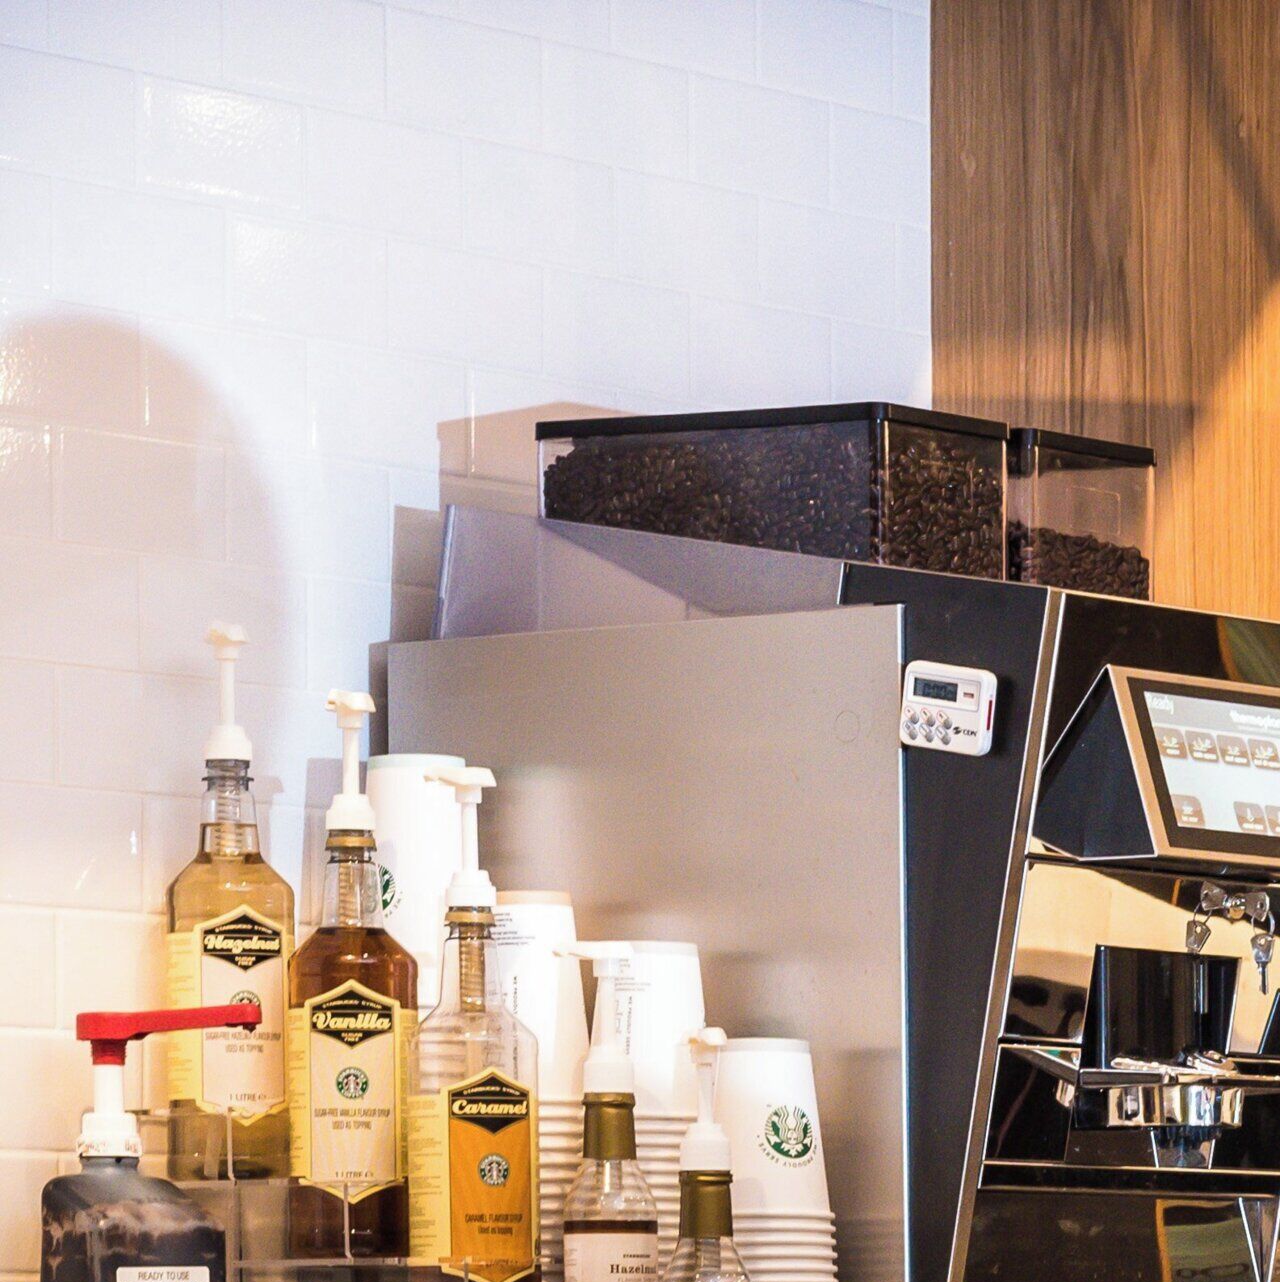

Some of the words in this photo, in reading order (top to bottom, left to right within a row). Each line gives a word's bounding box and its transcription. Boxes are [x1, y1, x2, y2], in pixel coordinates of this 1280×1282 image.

[204, 935, 280, 954] Hazelnut
[312, 1011, 391, 1029] Vanilla
[452, 1099, 527, 1115] Caramel
[138, 1271, 163, 1280] READY
[167, 1271, 176, 1280] TO
[177, 1271, 190, 1280] USE
